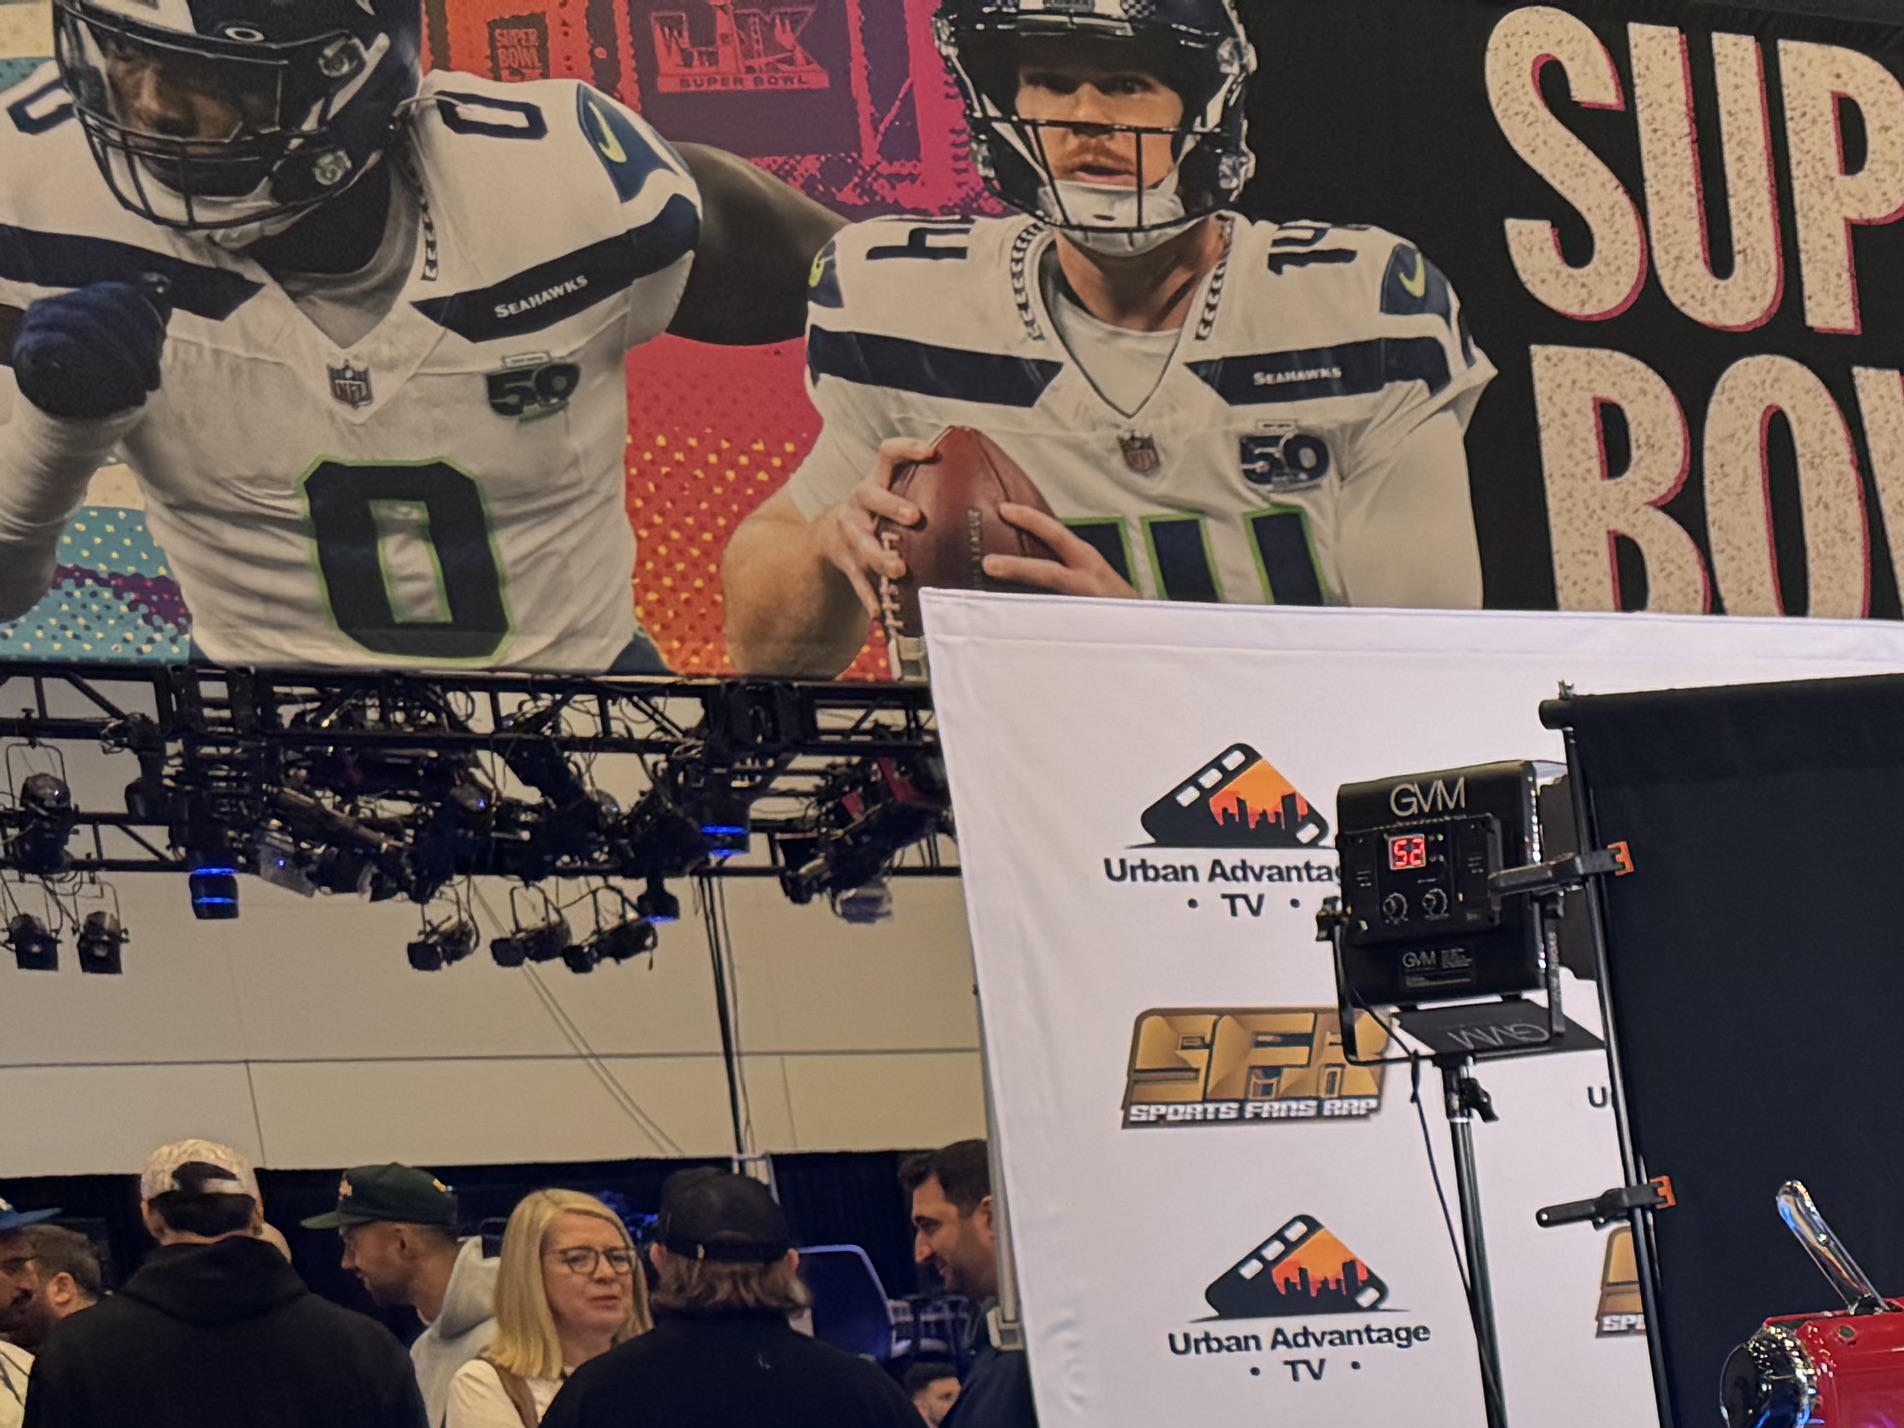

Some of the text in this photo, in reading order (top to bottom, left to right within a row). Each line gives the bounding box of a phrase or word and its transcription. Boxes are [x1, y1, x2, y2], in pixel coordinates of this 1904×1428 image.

[494, 28, 538, 46] SUPER
[496, 46, 541, 69] BOWL
[679, 74, 808, 89] SUPER BOWL
[494, 274, 588, 318] SEAHAWKS
[1252, 366, 1343, 387] SEAHAWKS
[1390, 777, 1466, 817] GVM
[1394, 838, 1425, 869] 52
[1104, 857, 1200, 884] Urban
[1220, 893, 1265, 918] TV
[1129, 1103, 1240, 1122] SPORTS
[1245, 1101, 1318, 1119] FANS
[1168, 1321, 1431, 1356] Urban Advantage
[1284, 1360, 1327, 1384] TV
